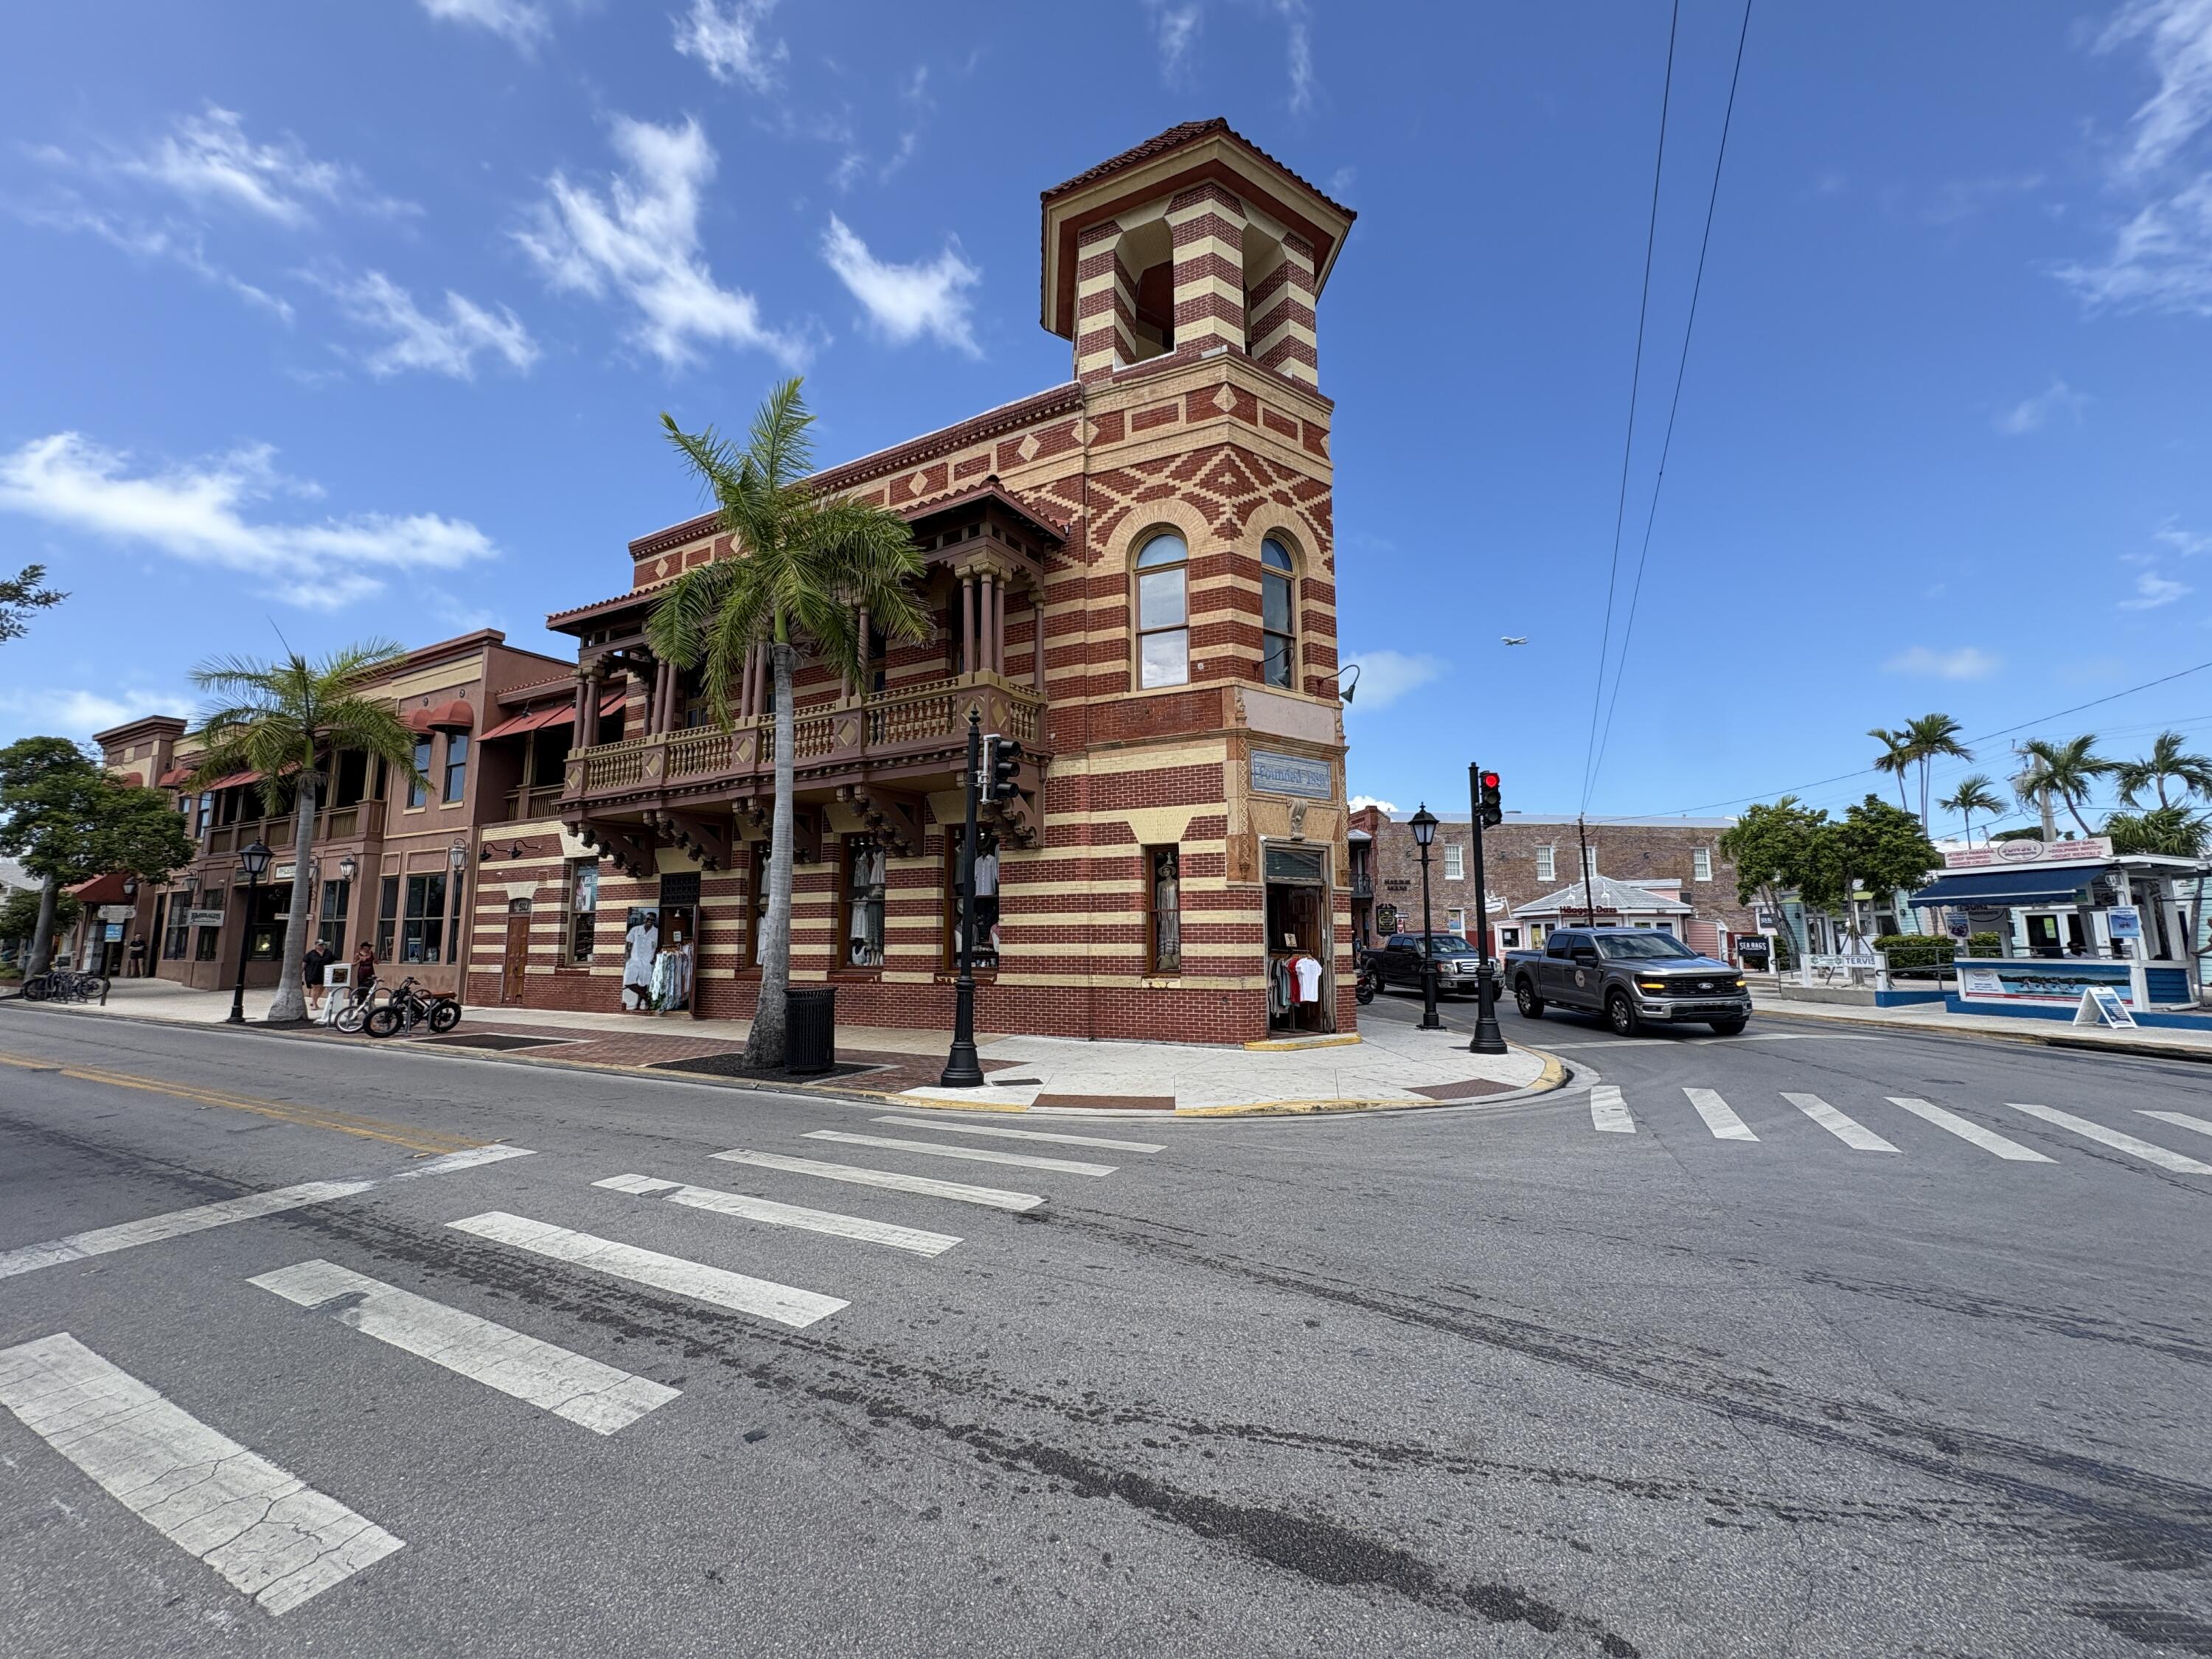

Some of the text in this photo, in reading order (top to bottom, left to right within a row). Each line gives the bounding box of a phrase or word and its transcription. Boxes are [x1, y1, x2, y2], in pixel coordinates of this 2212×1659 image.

[1256, 764, 1302, 784] Founded
[1559, 905, 1618, 915] Häage-Dazs
[1739, 942, 1767, 950] SEA BAGS
[1846, 957, 1876, 965] TERVIS
